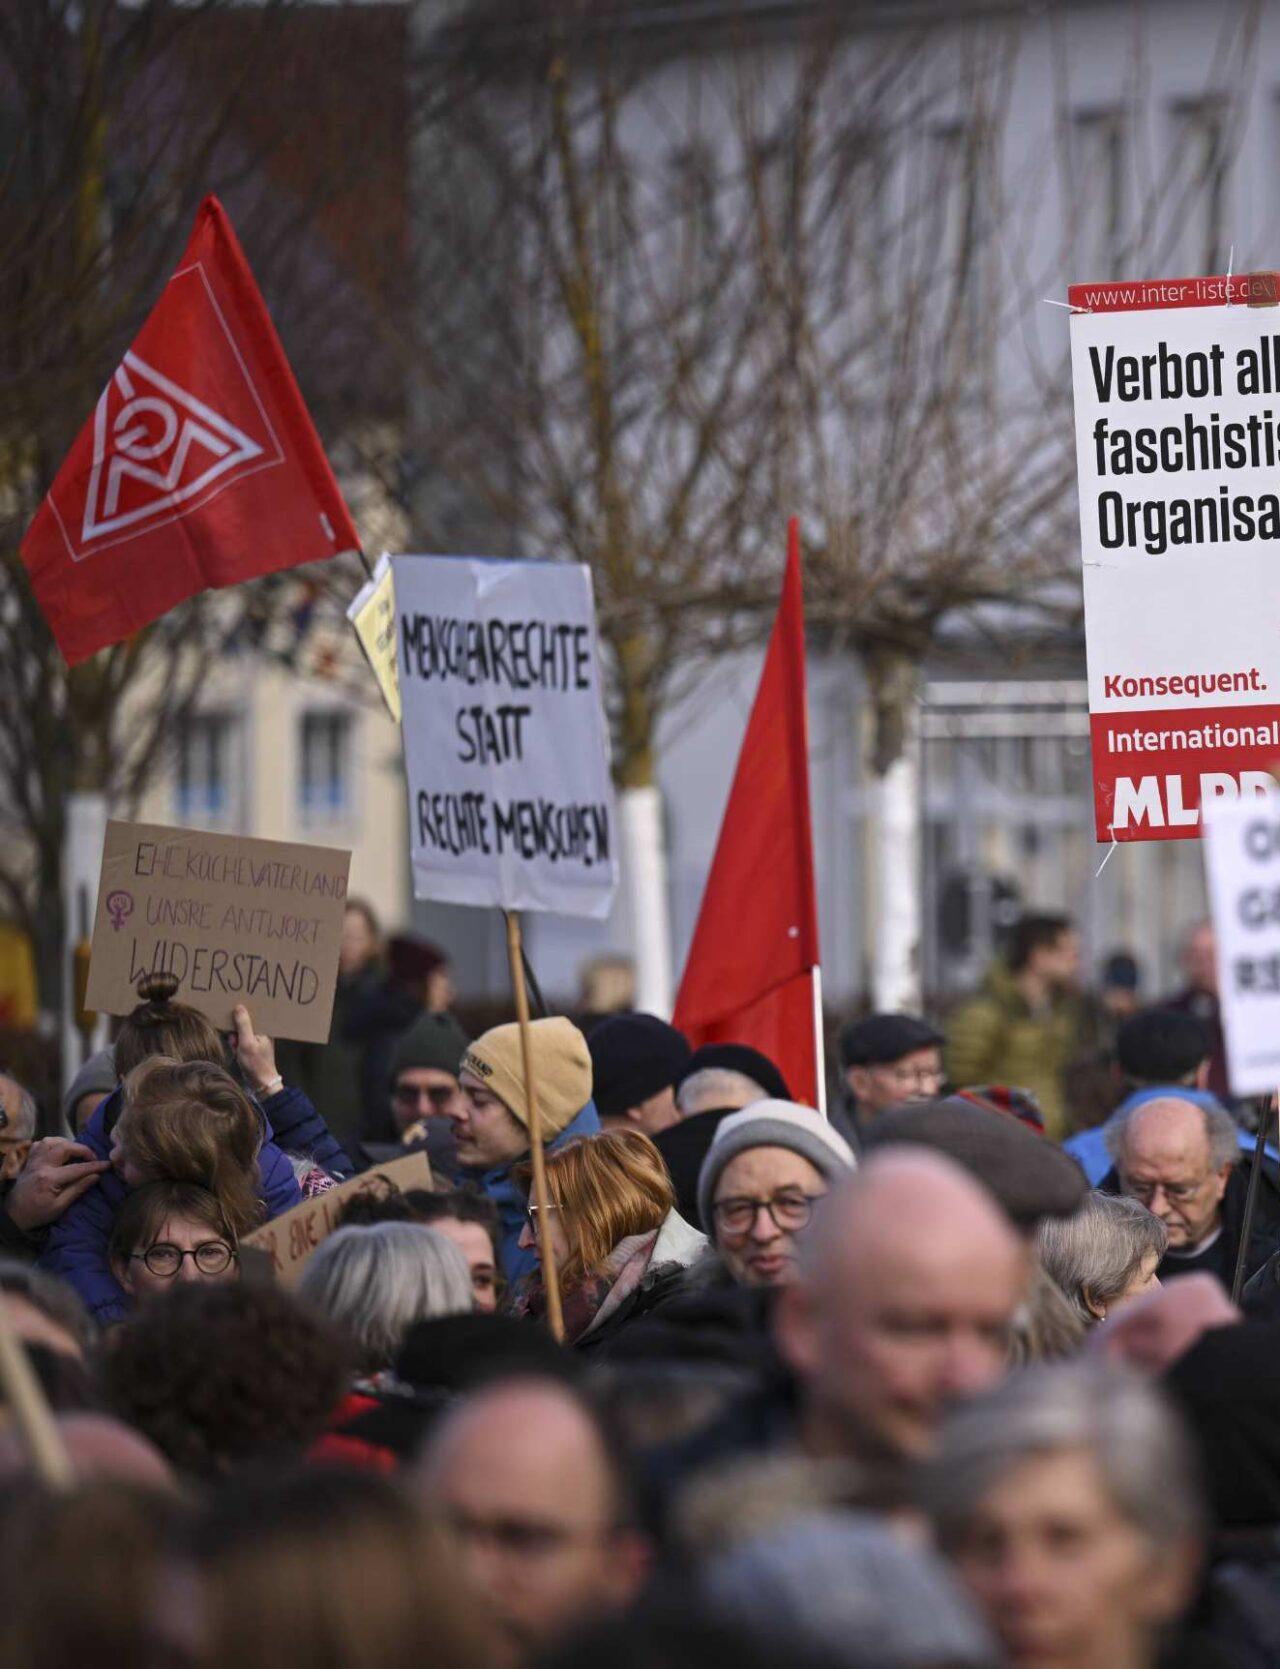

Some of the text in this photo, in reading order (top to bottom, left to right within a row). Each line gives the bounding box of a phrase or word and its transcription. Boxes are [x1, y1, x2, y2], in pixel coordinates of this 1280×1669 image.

[1089, 341, 1225, 403] Verbot
[1104, 668, 1267, 698] Konsequent.
[456, 705, 531, 764] STATT
[417, 790, 609, 866] RECHTE MENSCHEN
[220, 905, 323, 944] ANTWORT
[129, 938, 319, 1005] WIDERSTAND
